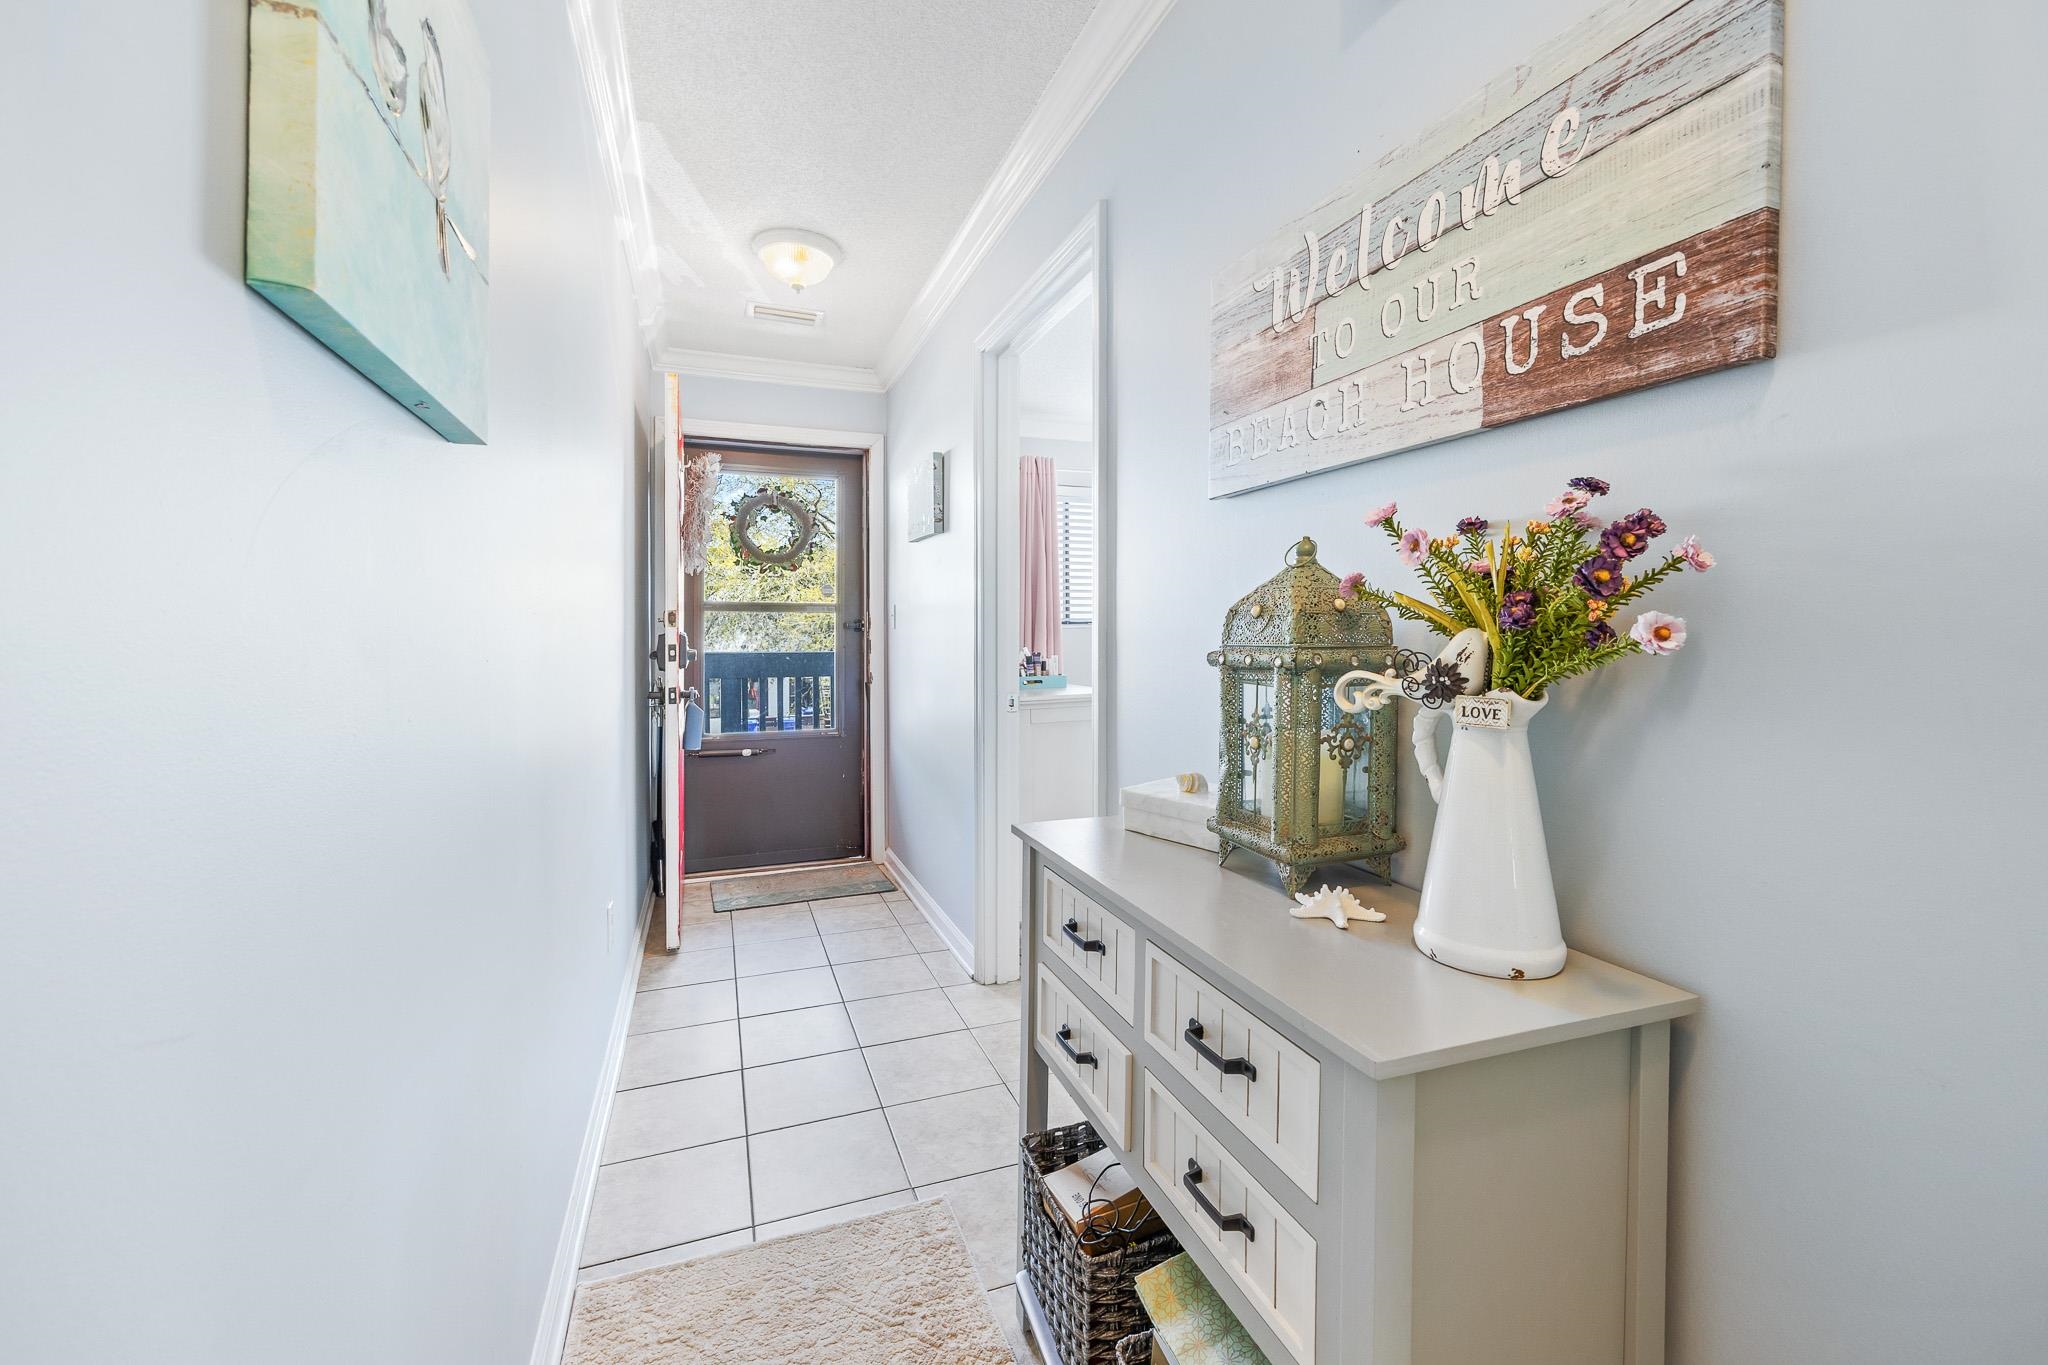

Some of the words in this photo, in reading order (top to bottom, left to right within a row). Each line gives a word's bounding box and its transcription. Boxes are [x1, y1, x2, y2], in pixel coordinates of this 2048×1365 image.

[1253, 106, 1594, 333] Welcome
[1225, 376, 1370, 467] BEACH
[1401, 251, 1688, 413] HOUSE
[1309, 317, 1355, 369] TO
[1381, 256, 1484, 338] OUR
[1461, 705, 1502, 720] LOVE
